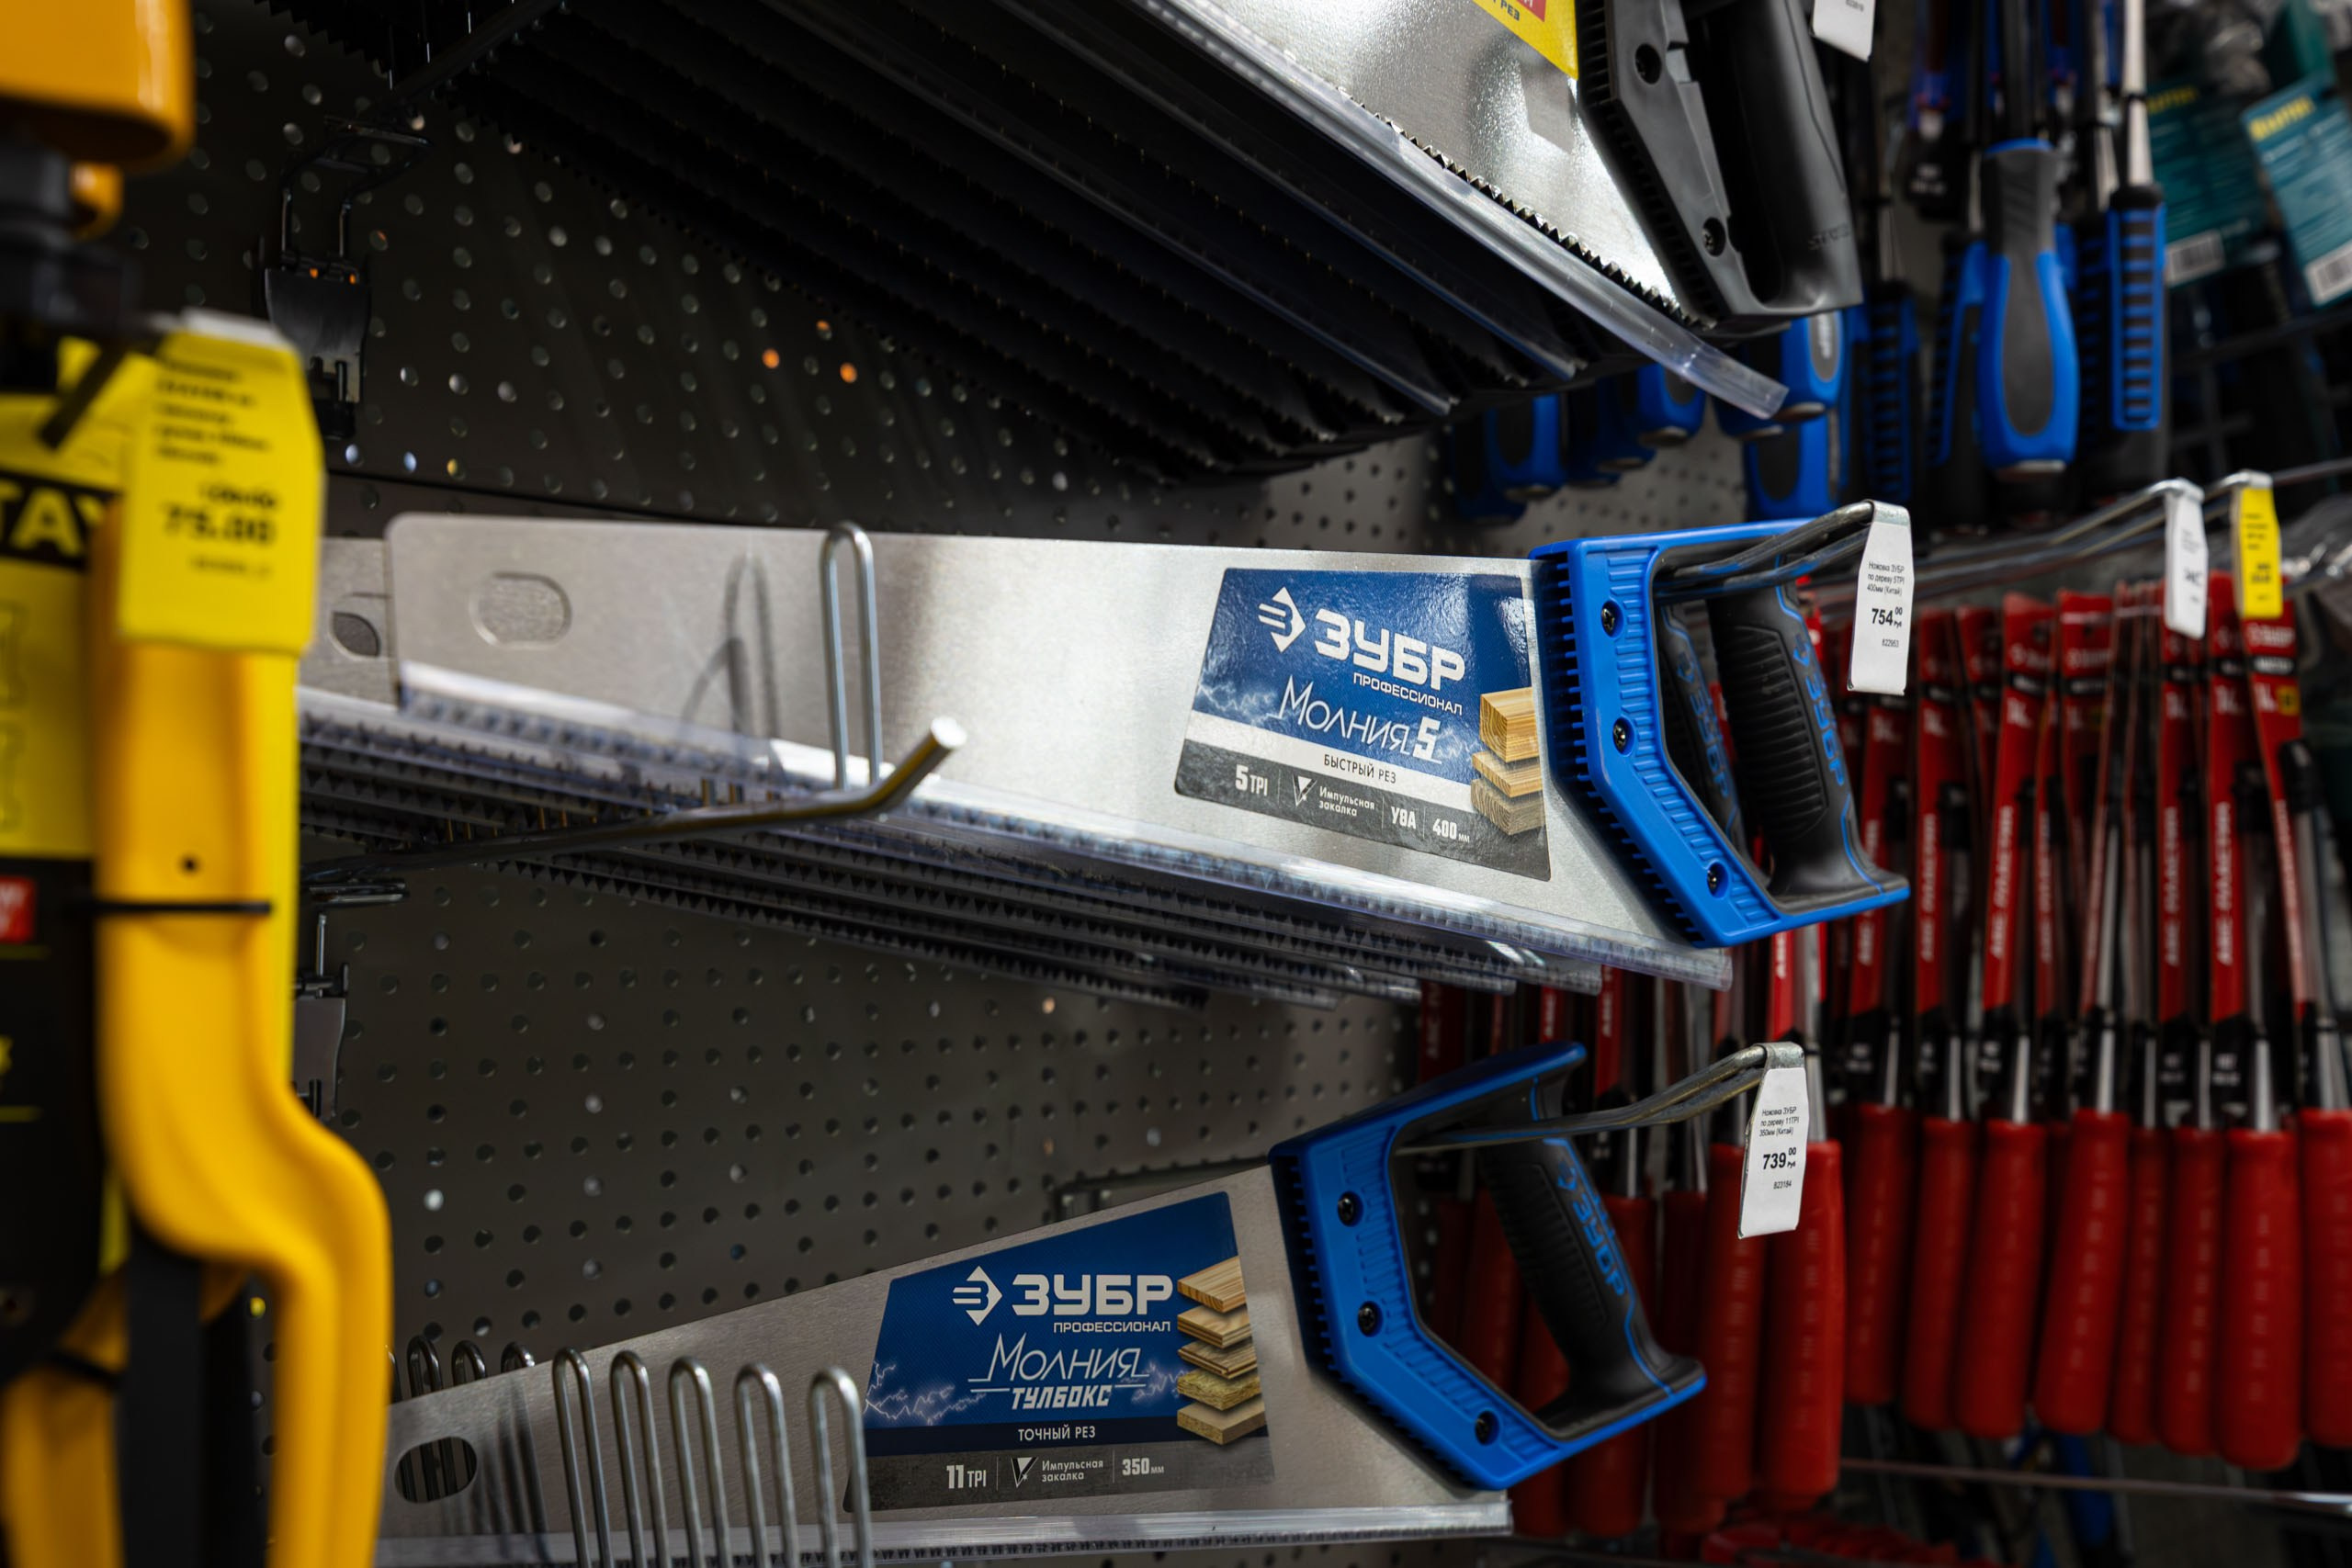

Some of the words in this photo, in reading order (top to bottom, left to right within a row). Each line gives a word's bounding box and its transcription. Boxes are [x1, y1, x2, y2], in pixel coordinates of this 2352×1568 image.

[1868, 561, 1890, 571] Ножовка
[1891, 564, 1905, 573] ЗУБР
[1875, 574, 1893, 585] дереву
[1871, 608, 1894, 626] 754
[1894, 606, 1903, 615] 00
[1314, 607, 1465, 691] ЗУБР
[1352, 671, 1463, 716] ПРОФЕССИОНАЛ
[1412, 716, 1442, 763] 5
[1324, 753, 1374, 778] БЫСТРЫЙ
[1378, 768, 1396, 784] РЕЗ
[1319, 785, 1375, 810] Импульсная
[1318, 800, 1357, 817] закалка
[1783, 1106, 1796, 1114] ЗУБР
[1767, 1119, 1784, 1127] дереву
[1762, 1152, 1786, 1170] 739
[1788, 1146, 1796, 1156] 00
[1012, 1273, 1173, 1316] ЗУБР
[1053, 1320, 1170, 1333] ПРОФЕССИОНАЛ
[1011, 1383, 1112, 1410] ТУЛБОКС
[1018, 1424, 1070, 1440] ТОЧНЫЙ
[1075, 1425, 1096, 1439] РЕЗ
[1042, 1460, 1104, 1472] Импульсная
[1042, 1472, 1084, 1483] закалка
